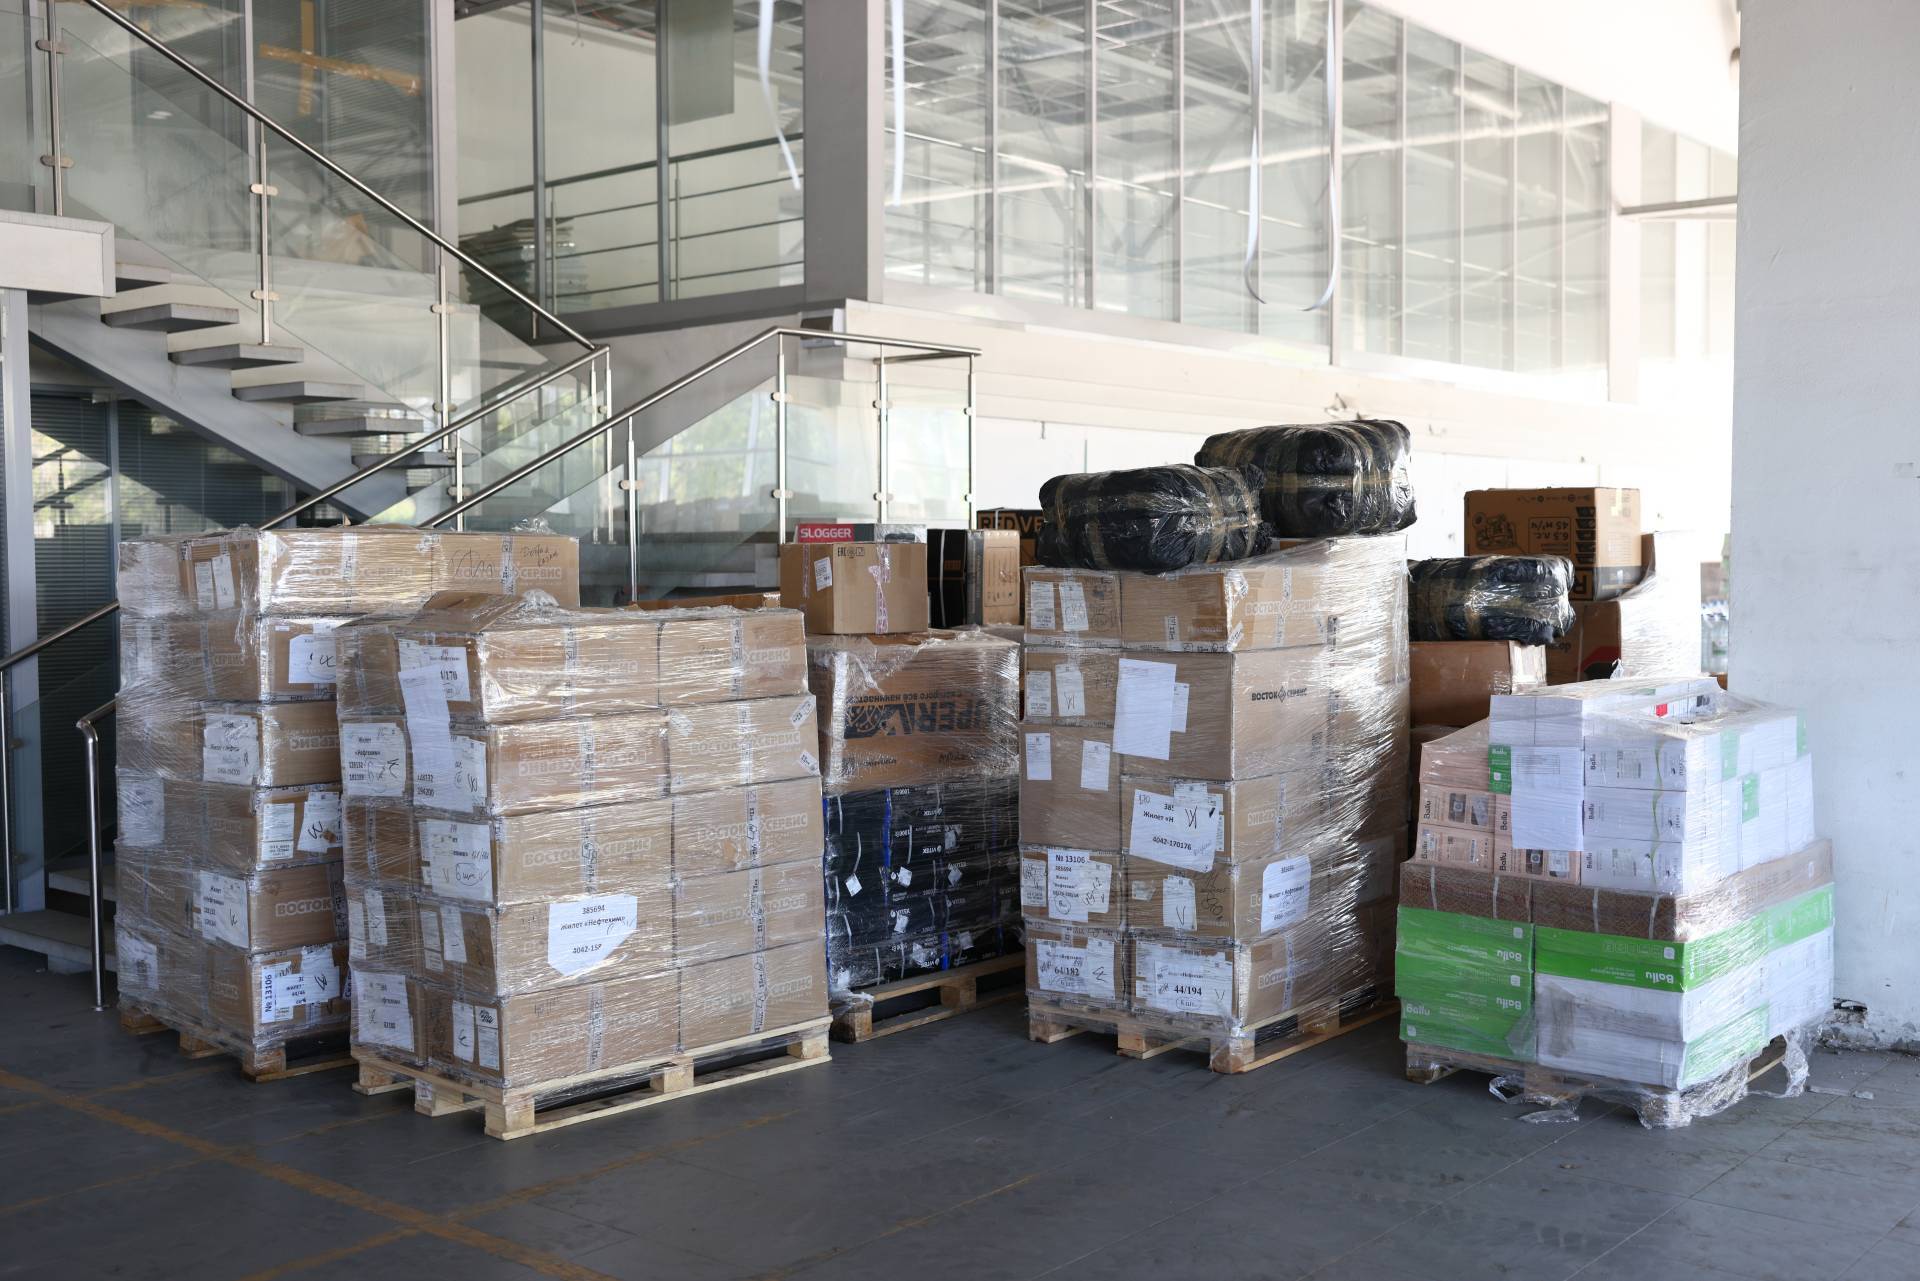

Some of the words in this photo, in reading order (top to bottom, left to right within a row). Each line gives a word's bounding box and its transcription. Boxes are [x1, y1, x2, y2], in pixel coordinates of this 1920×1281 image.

[800, 528, 852, 538] SLOGGER
[1252, 691, 1278, 701] ВОСТОК
[1143, 811, 1164, 821] Жилет
[1152, 836, 1192, 850] 4042-170176
[276, 899, 331, 917] ВОСТОК
[582, 904, 605, 915] 385694
[1497, 949, 1522, 962] Ballu
[1645, 970, 1675, 985] Ballu
[264, 974, 272, 999] 13106
[1173, 984, 1202, 995] 44/194
[1406, 1003, 1431, 1016] Ballu
[1496, 997, 1522, 1010] Ballu
